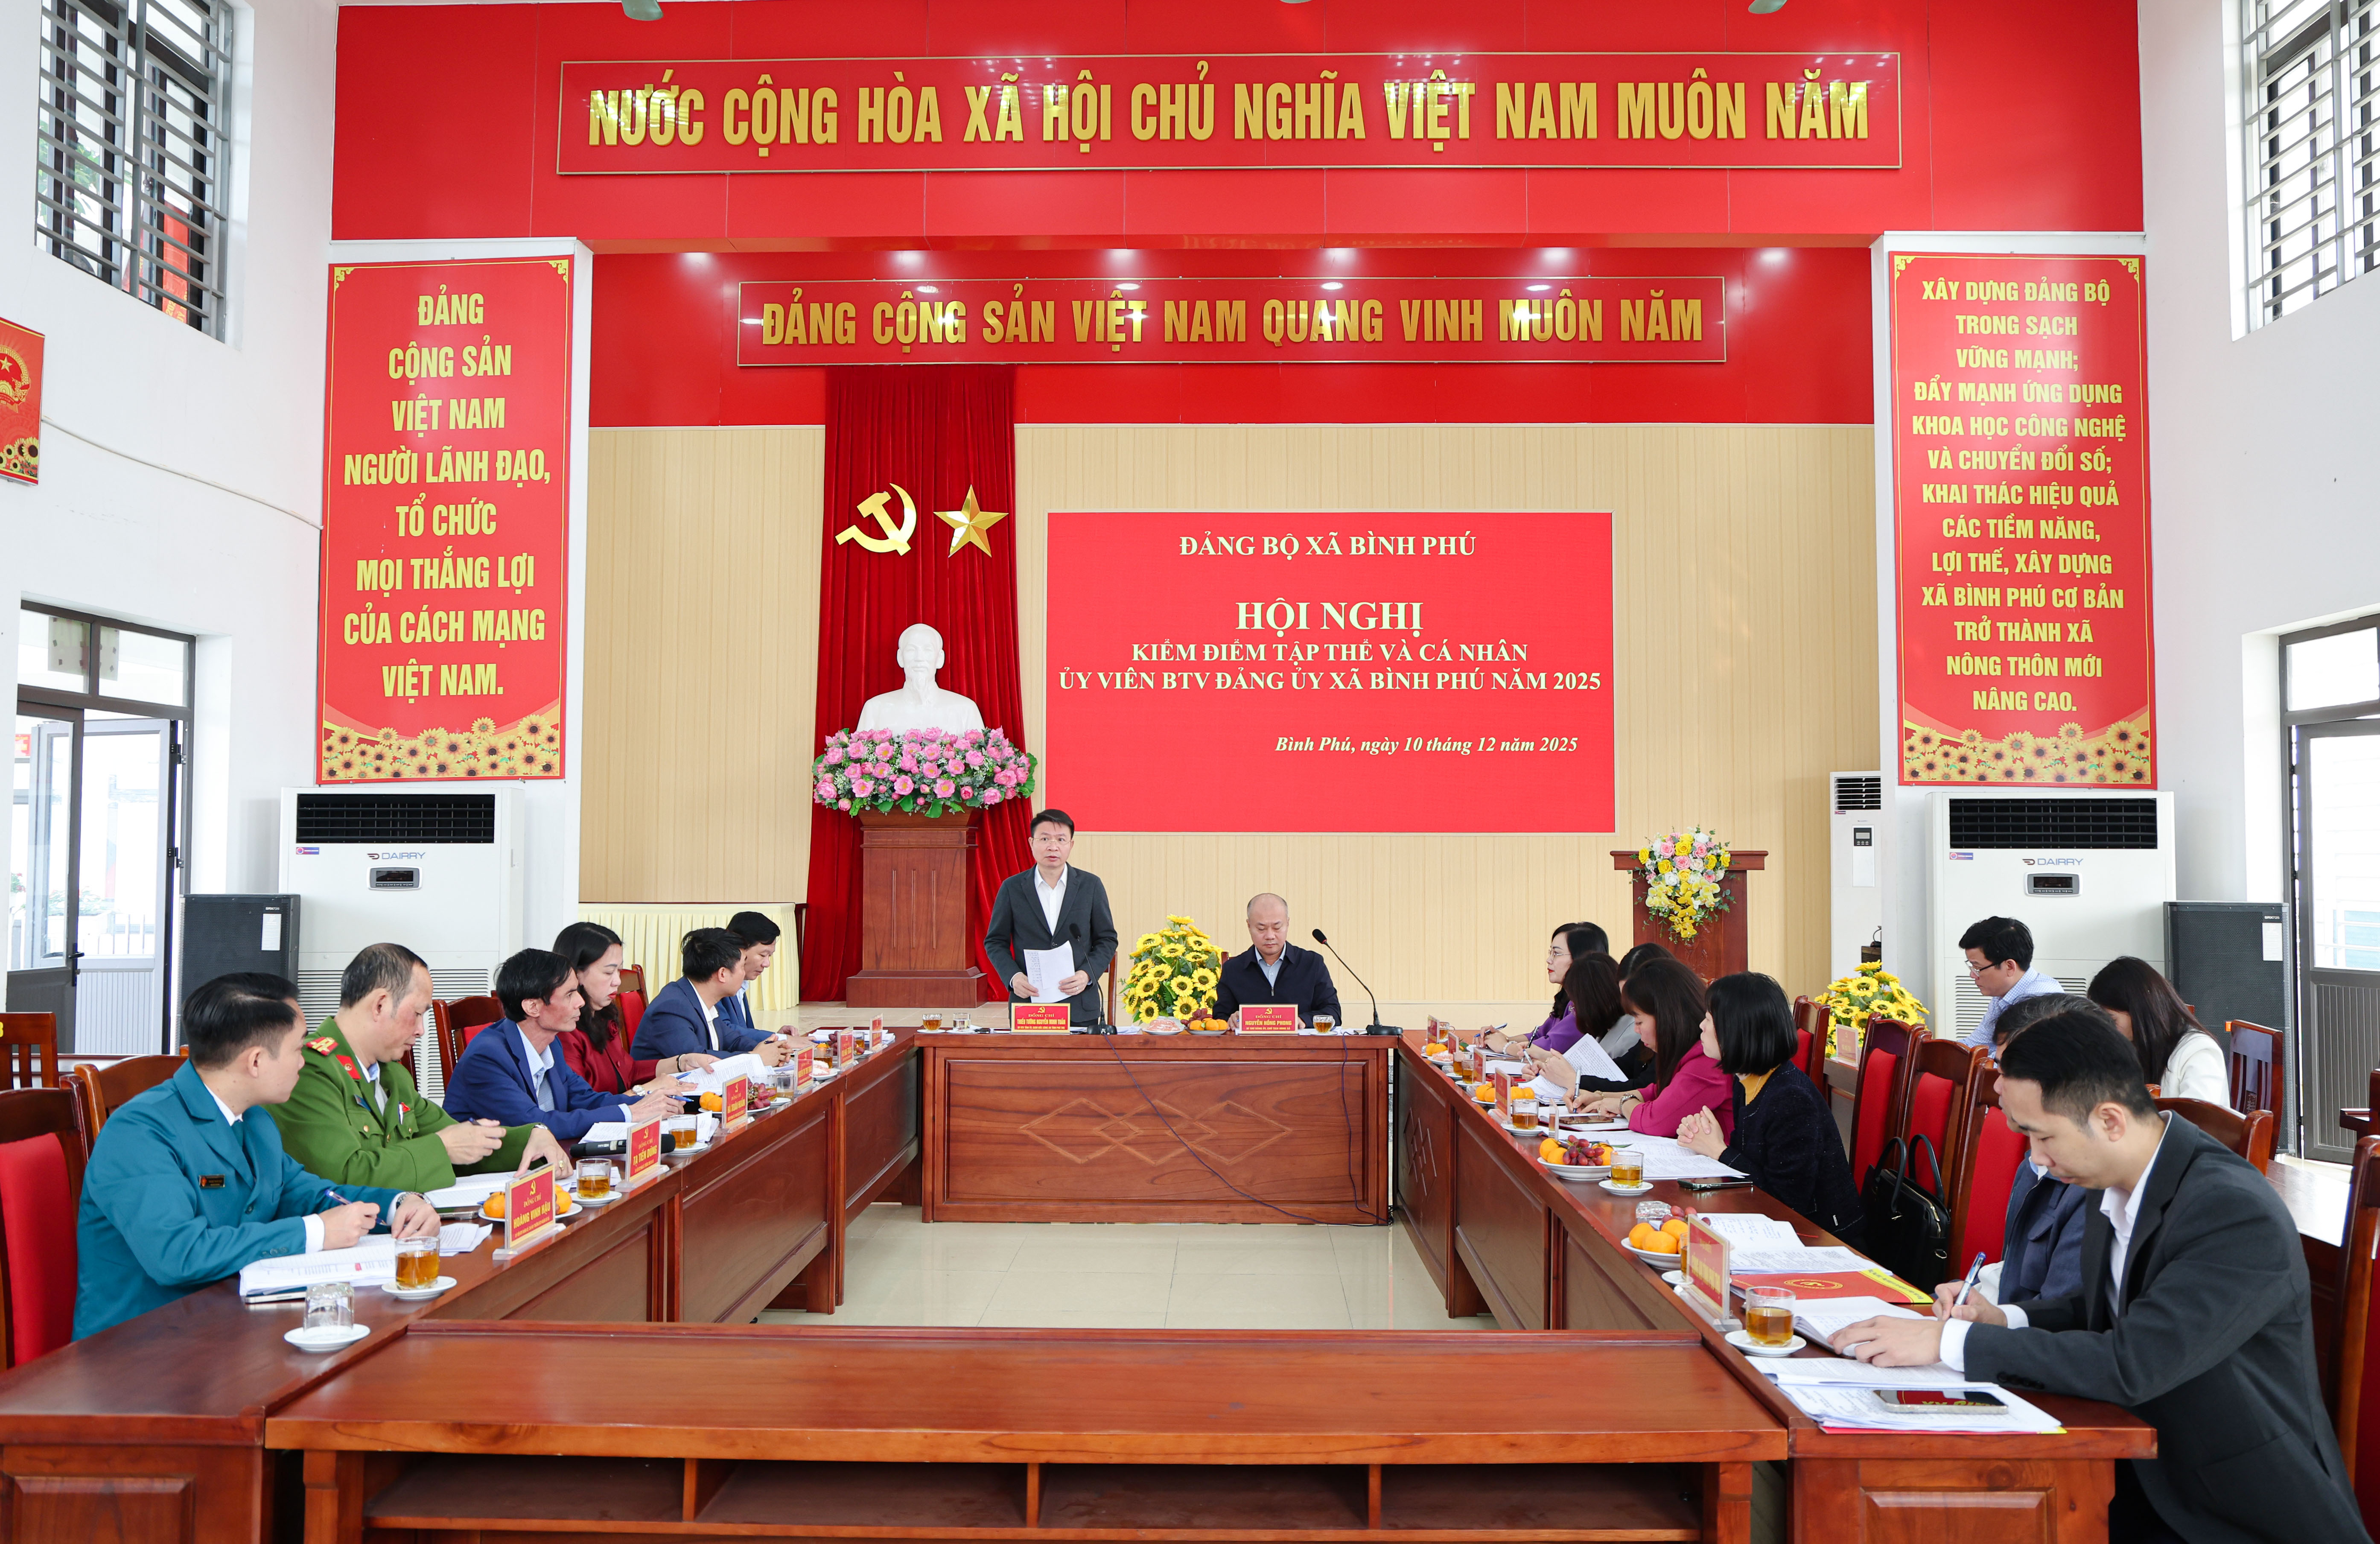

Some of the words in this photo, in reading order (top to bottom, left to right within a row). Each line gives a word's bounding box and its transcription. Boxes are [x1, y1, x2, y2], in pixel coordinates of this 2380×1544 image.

[589, 69, 704, 146] NƯỚC
[723, 74, 837, 157] CỘNG
[858, 72, 942, 143] HÒA
[963, 73, 1024, 142] XÃ
[1043, 70, 1111, 152] HỘI
[1132, 61, 1214, 140] CHỦ
[1235, 70, 1365, 140] NGHĨA
[1384, 69, 1475, 152] VIỆT
[1496, 83, 1597, 139] NAM
[1618, 68, 1746, 139] MUÔN
[1766, 69, 1868, 139] NĂM
[418, 284, 484, 325] ĐẢNG
[1922, 277, 1960, 300] XÂY
[1966, 280, 2019, 304] DỰNG
[2025, 277, 2078, 301] ĐẢNG
[2085, 279, 2109, 306] BỘ
[762, 288, 855, 344] ĐẢNG
[873, 291, 965, 353] CỘNG
[983, 284, 1054, 343] SẢN
[1072, 290, 1146, 351] VIỆT
[1164, 301, 1245, 341] NAM
[1263, 299, 1382, 346] QUANG
[1400, 300, 1482, 341] VINH
[1499, 289, 1602, 341] MUÔN
[1621, 289, 1702, 341] NĂM
[1956, 315, 2020, 334] TRONG
[2027, 316, 2077, 338] SẠCH
[389, 341, 454, 381] CỘNG
[462, 335, 511, 376] SẢN
[1957, 345, 2008, 368] VỮNG
[2015, 350, 2078, 372] MẠNH;
[1914, 374, 1952, 400] ĐẨY
[1959, 382, 2016, 405] MẠNH
[2024, 380, 2062, 402] ỨNG
[2070, 384, 2122, 407] DỤNG
[392, 394, 442, 437] VIỆT
[449, 398, 505, 429] NAM
[1913, 416, 1965, 435] KHOA
[1971, 417, 2009, 439] HỌC
[2016, 414, 2068, 436] CÔNG
[2075, 414, 2126, 441] NGHỆ
[344, 445, 418, 485] NGƯỜI
[426, 446, 488, 482] LÃNH
[496, 449, 550, 487] ĐẠO,
[1928, 447, 1953, 469] VÀ
[1959, 444, 2035, 470] CHUYỂN
[2041, 444, 2073, 470] ĐỔI
[2080, 446, 2111, 473] SỐ;
[1923, 484, 1968, 503] KHAI
[1974, 481, 2023, 504] THÁC
[2030, 482, 2073, 509] HIỆU
[2080, 480, 2119, 507] QUẢ
[396, 493, 426, 536] TỔ
[433, 497, 496, 536] CHỨC
[1943, 515, 1980, 537] CÁC
[1986, 513, 2033, 538] TIỀM
[2040, 516, 2100, 542] NĂNG,
[1179, 531, 1255, 555] ĐẢNG
[1262, 534, 1299, 560] BỘ
[1306, 532, 1342, 555] XÃ
[1350, 531, 1415, 555] BÌNH
[1422, 531, 1476, 555] PHÚ
[357, 559, 402, 597] MỌI
[411, 546, 489, 589] THẮNG
[498, 553, 534, 594] LỢI
[1932, 551, 1961, 575] LỢI
[1968, 547, 2009, 575] THẾ,
[2015, 550, 2052, 573] XÂY
[2059, 553, 2112, 578] DỰNG
[1922, 583, 1948, 606] XÃ
[1954, 583, 2000, 606] BÌNH
[2007, 584, 2045, 607] PHÚ
[2052, 587, 2077, 608] CƠ
[2084, 583, 2123, 608] BẢN
[344, 602, 392, 645] CỦA
[400, 605, 464, 643] CÁCH
[472, 609, 545, 647] MẠNG
[1236, 598, 1310, 637] HỘI
[1320, 602, 1423, 637] NGHỊ
[1954, 616, 1991, 641] TRỞ
[1996, 619, 2061, 642] THÀNH
[2067, 620, 2093, 642] XÃ
[1132, 639, 1196, 660] KIỂM
[1203, 639, 1266, 660] ĐIỂM
[1273, 641, 1319, 665] TẬP
[1324, 639, 1373, 660] THỂ
[1380, 639, 1413, 660] VÀ
[1420, 639, 1452, 661] CÁ
[1459, 639, 1528, 661] NHÂN
[1947, 652, 2001, 675] NÔNG
[2007, 653, 2058, 676] THÔN
[2065, 654, 2102, 677] MỚI
[382, 658, 433, 703] VIỆT
[440, 664, 503, 695] NAM.
[1059, 667, 1092, 689] ỦY
[1097, 667, 1155, 689] VIÊN
[1162, 672, 1210, 689] BTV
[1215, 667, 1284, 689] ĐẢNG
[1291, 667, 1324, 689] ỦY
[1330, 668, 1363, 689] XÃ
[1370, 667, 1429, 689] BÌNH
[1436, 668, 1485, 689] PHÚ
[1491, 668, 1547, 689] NĂM
[1554, 672, 1600, 689] 2025
[1973, 687, 2027, 710] NÂNG
[2034, 692, 2077, 711] CAO.
[1275, 737, 1314, 751] Bình
[1318, 737, 1355, 753] Phú,
[1361, 737, 1399, 755] ngày
[1404, 737, 1423, 751] 10
[1426, 737, 1472, 755] tháng
[1478, 737, 1496, 751] 12
[1500, 738, 1534, 751] năm
[1540, 737, 1578, 751] 2025
[633, 1155, 638, 1167] TẠ
[513, 1212, 530, 1229] HOÀNG
[530, 1206, 541, 1220] VINH
[541, 1201, 551, 1215] HẬU
[524, 1197, 534, 1208] ĐỒNG
